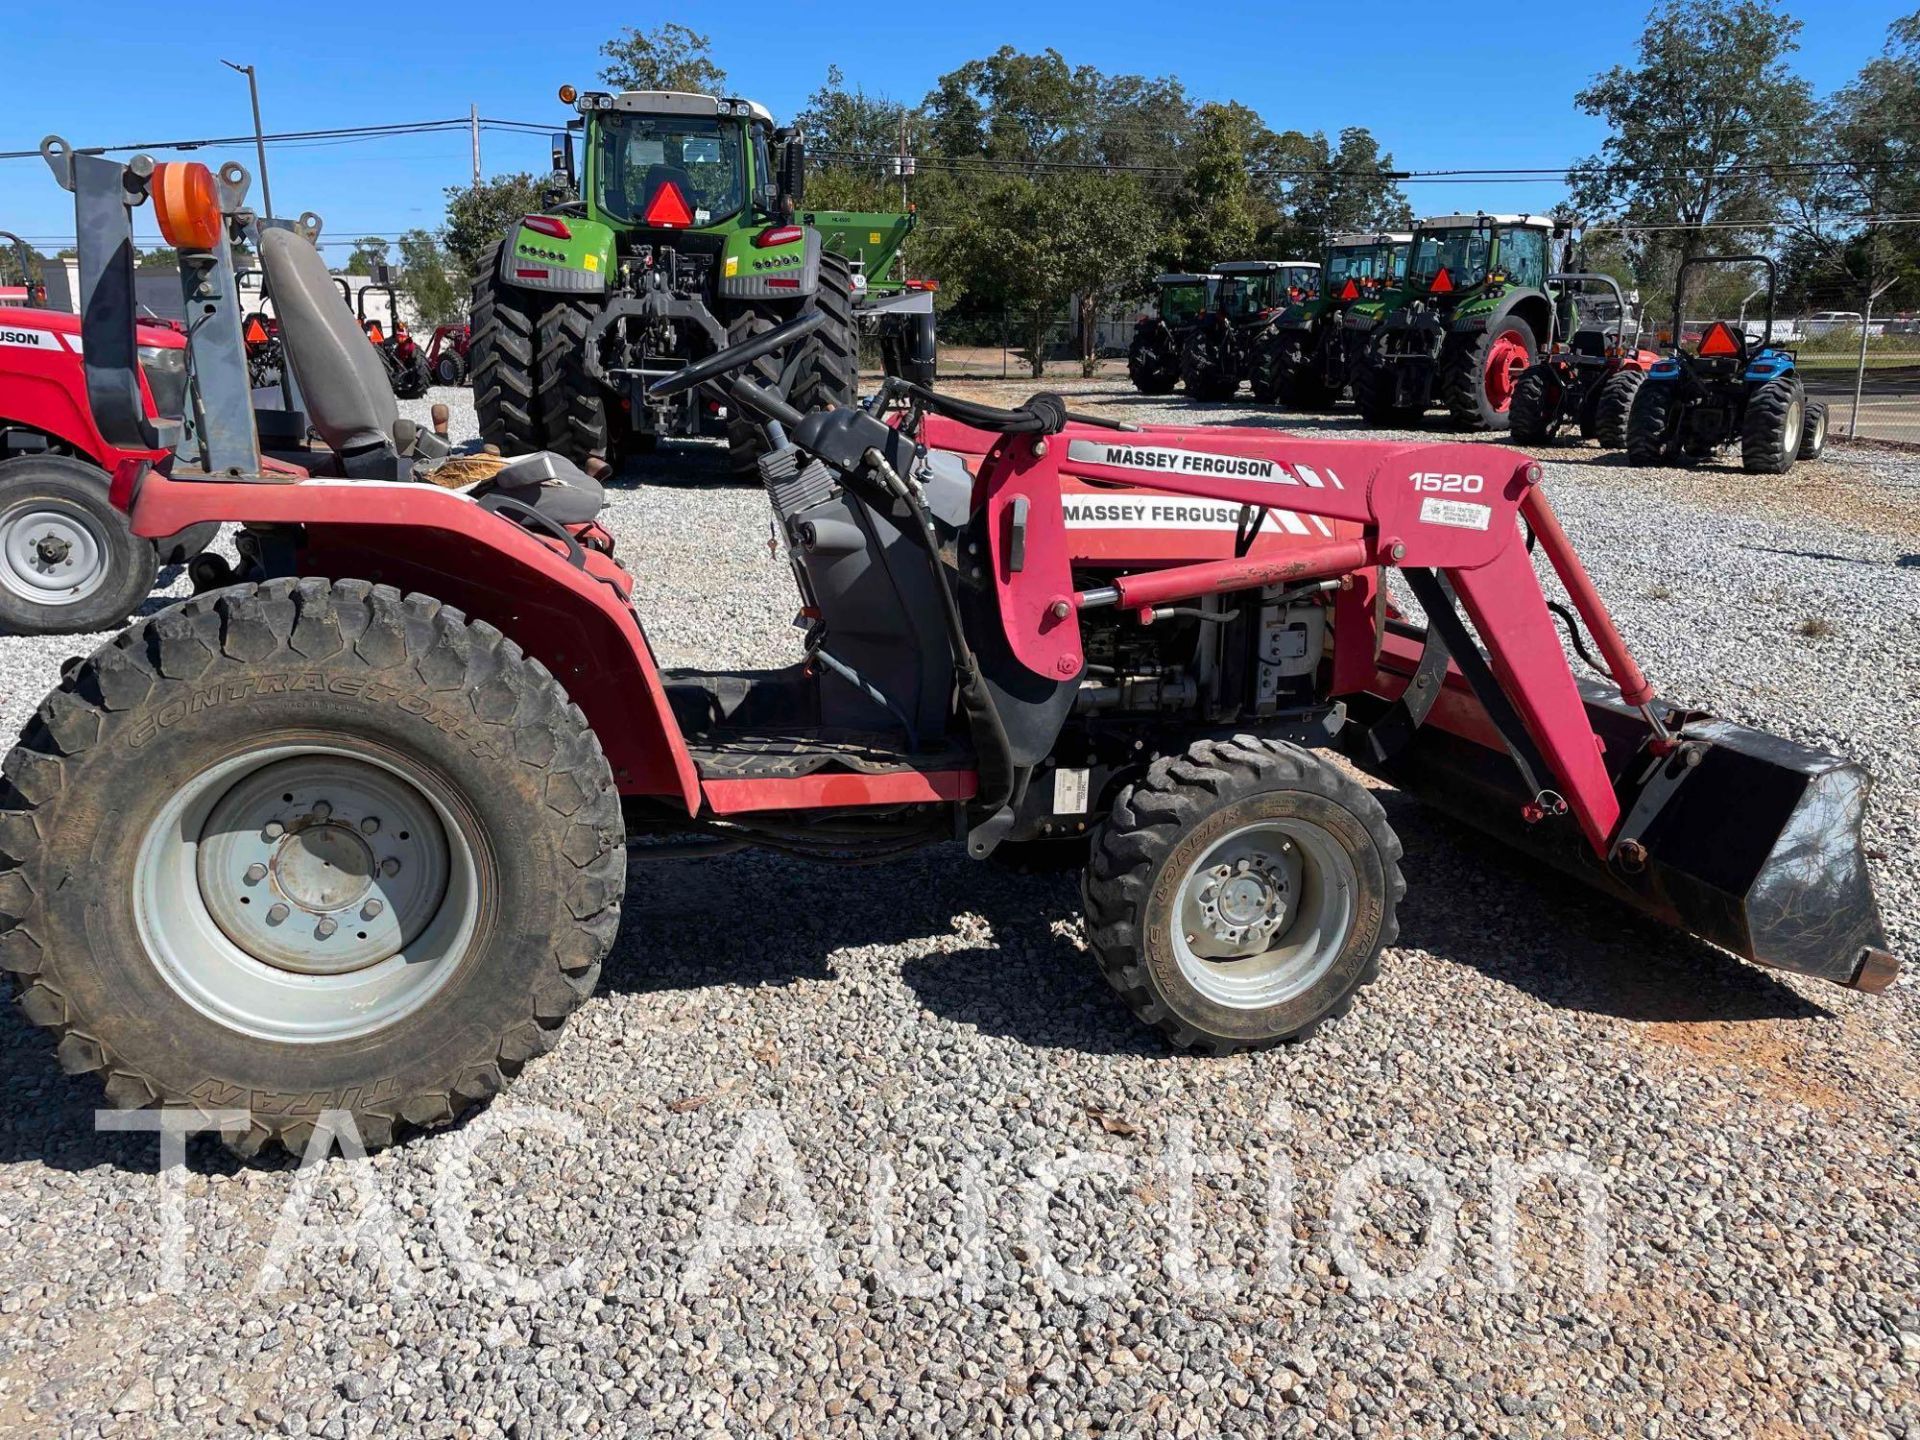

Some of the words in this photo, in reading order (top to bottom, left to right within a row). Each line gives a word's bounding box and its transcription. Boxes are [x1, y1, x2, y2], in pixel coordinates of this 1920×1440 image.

[1106, 448, 1178, 468] MASSEY
[1182, 456, 1273, 477] FERGUSON
[1408, 472, 1484, 493] 1520
[1063, 505, 1145, 521] MASSEY
[128, 673, 499, 760] CONTRACTOR-T
[186, 1076, 397, 1116] TITAN
